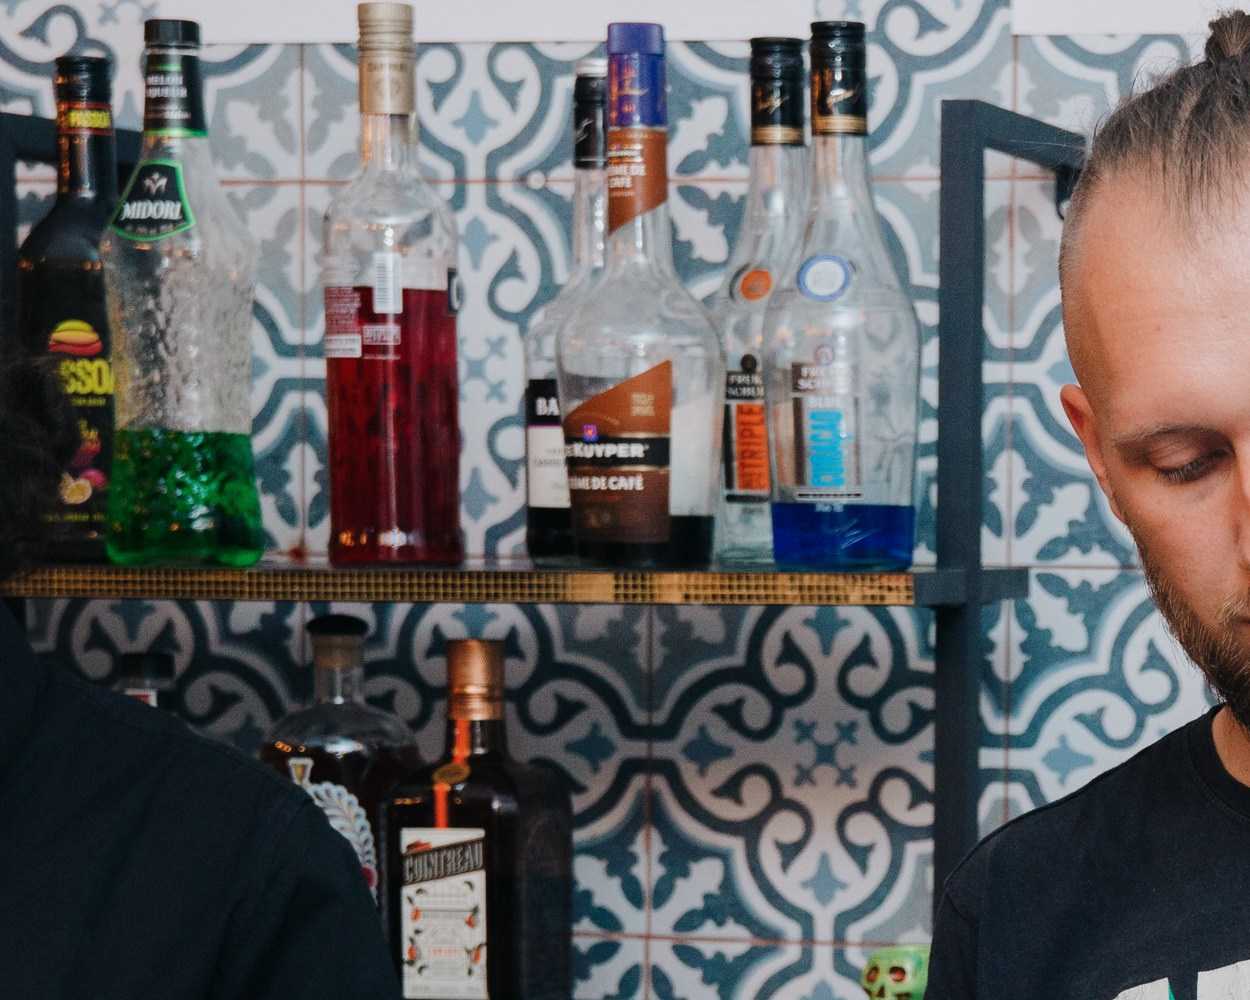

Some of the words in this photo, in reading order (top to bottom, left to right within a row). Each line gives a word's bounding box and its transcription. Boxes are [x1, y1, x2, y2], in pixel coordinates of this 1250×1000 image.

[119, 199, 184, 221] MIDORI
[608, 474, 645, 491] CAFÉ
[404, 841, 482, 883] COINTREAU
